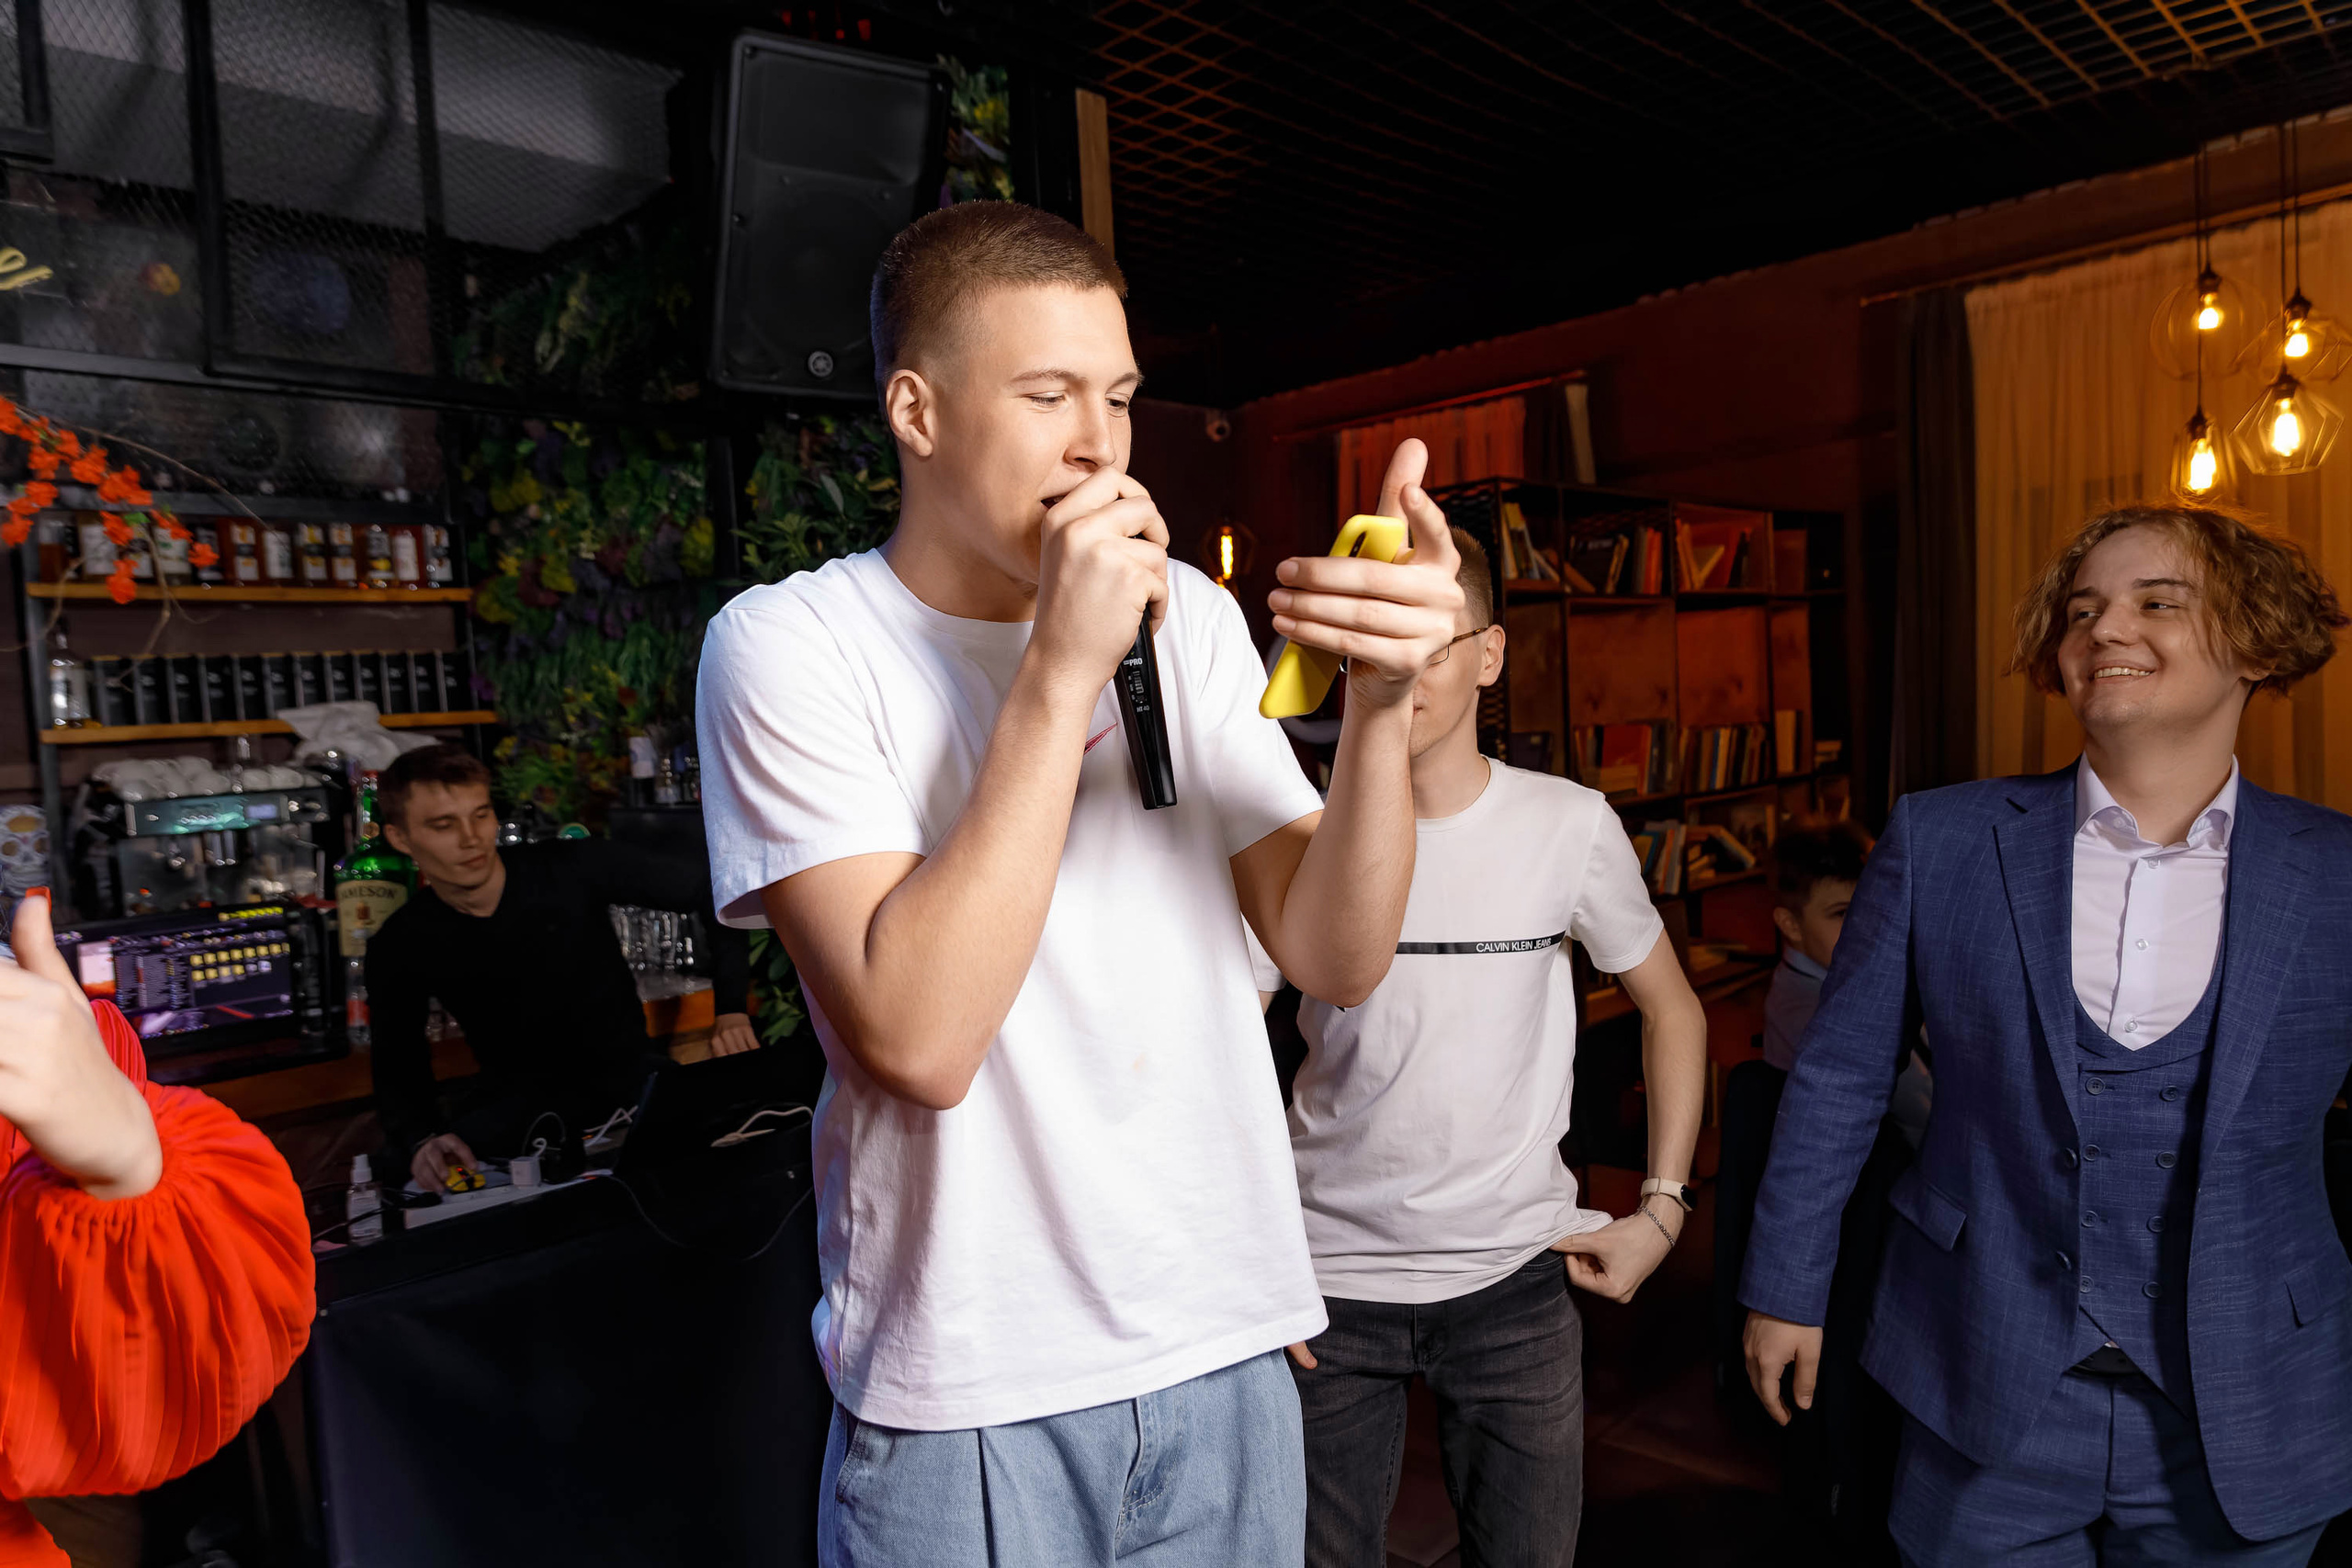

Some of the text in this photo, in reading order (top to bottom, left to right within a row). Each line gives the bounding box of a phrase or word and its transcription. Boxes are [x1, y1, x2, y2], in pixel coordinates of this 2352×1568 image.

[1476, 938, 1552, 953] CALVIN KLEIN JEANS
